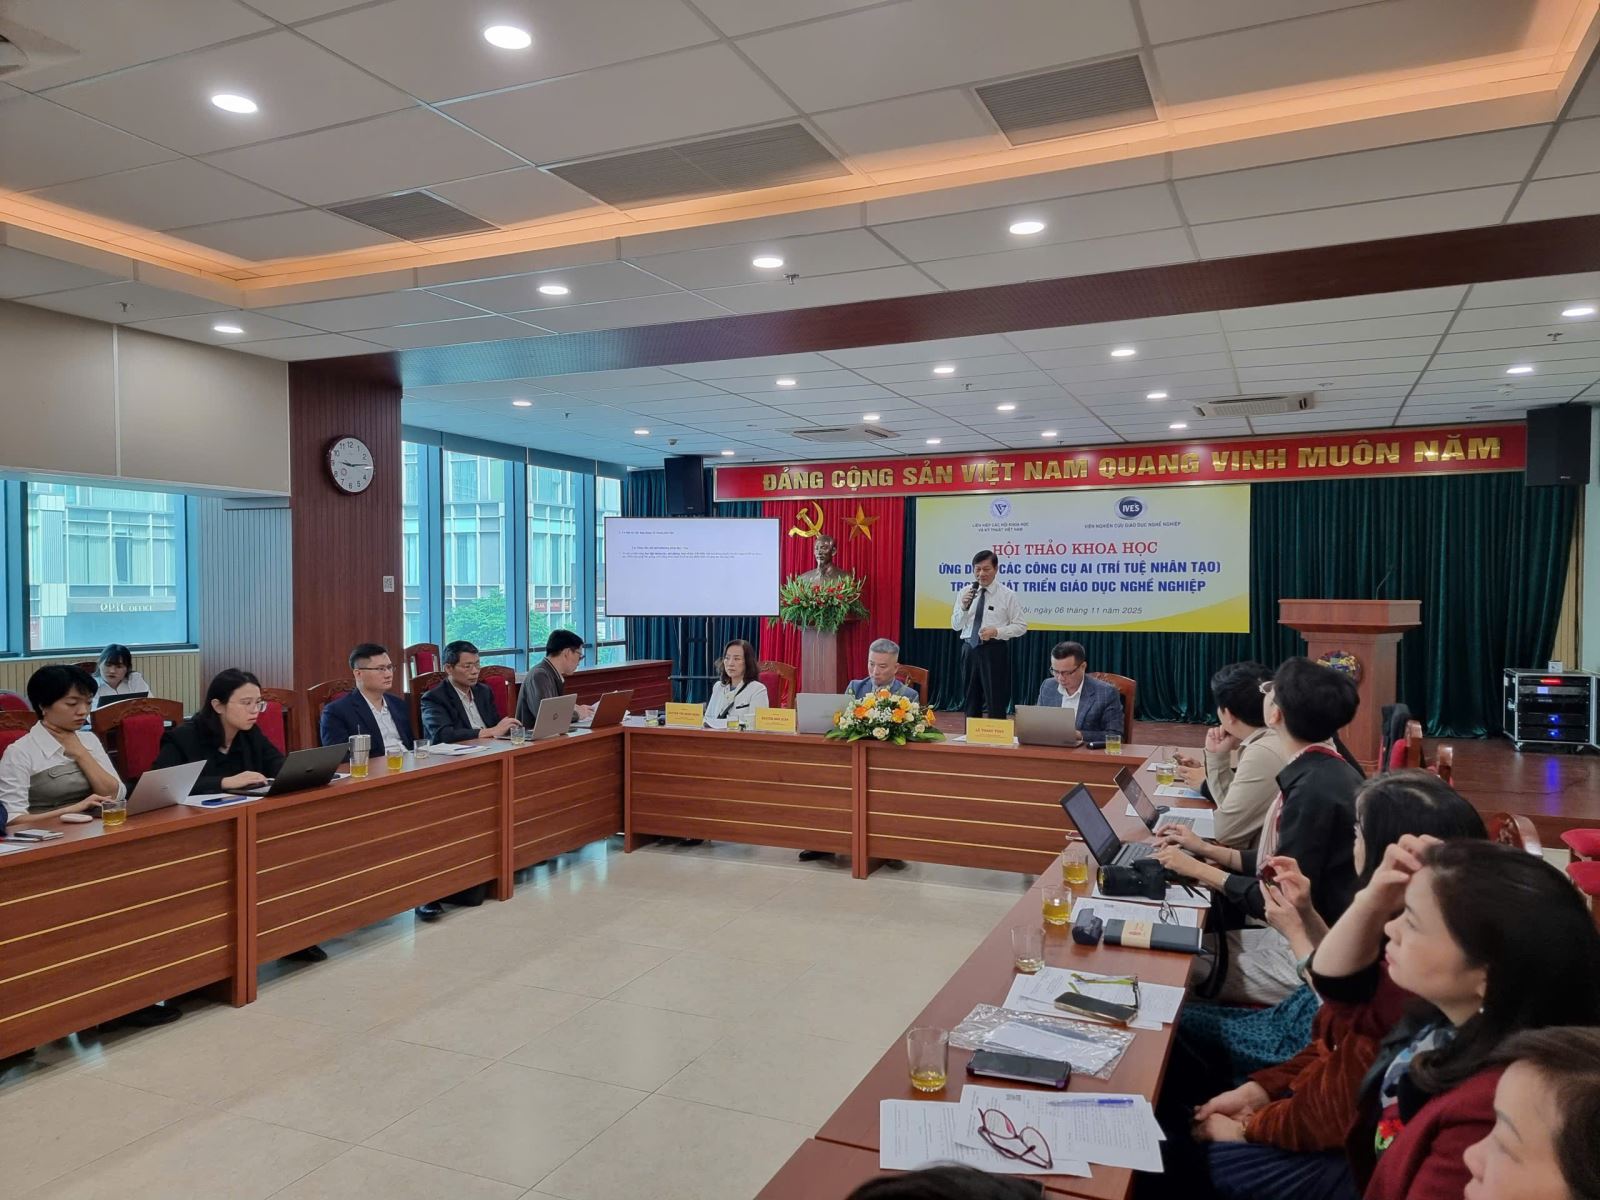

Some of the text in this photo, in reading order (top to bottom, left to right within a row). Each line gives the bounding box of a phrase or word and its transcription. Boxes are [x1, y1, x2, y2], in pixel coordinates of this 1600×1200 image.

[339, 442, 345, 450] 11
[347, 441, 354, 449] 12
[763, 433, 1500, 491] ĐẢNG CỘNG SẢN VIỆT NAM QUANG VINH MUÔN NĂM
[992, 539, 1158, 558] HỘI THẢO KHOA HỌC
[939, 562, 961, 575] ỨNG
[999, 562, 1021, 575] CÁC
[1025, 562, 1057, 575] CÔNG
[1060, 563, 1076, 576] CỤ
[1080, 564, 1092, 574] AI
[1096, 560, 1120, 575] (TRÍ
[1124, 560, 1146, 576] TUỆ
[1150, 560, 1187, 573] NHÂN
[1190, 561, 1220, 575] TẠO)
[1023, 578, 1056, 592] TRIỂN
[1060, 580, 1088, 592] GIÁO
[1092, 581, 1116, 594] DỤC
[1158, 578, 1206, 594] NGHIỆP
[1034, 606, 1052, 616] ngày
[1054, 606, 1064, 614] 06
[1066, 605, 1089, 616] tháng
[1102, 606, 1120, 614] năm
